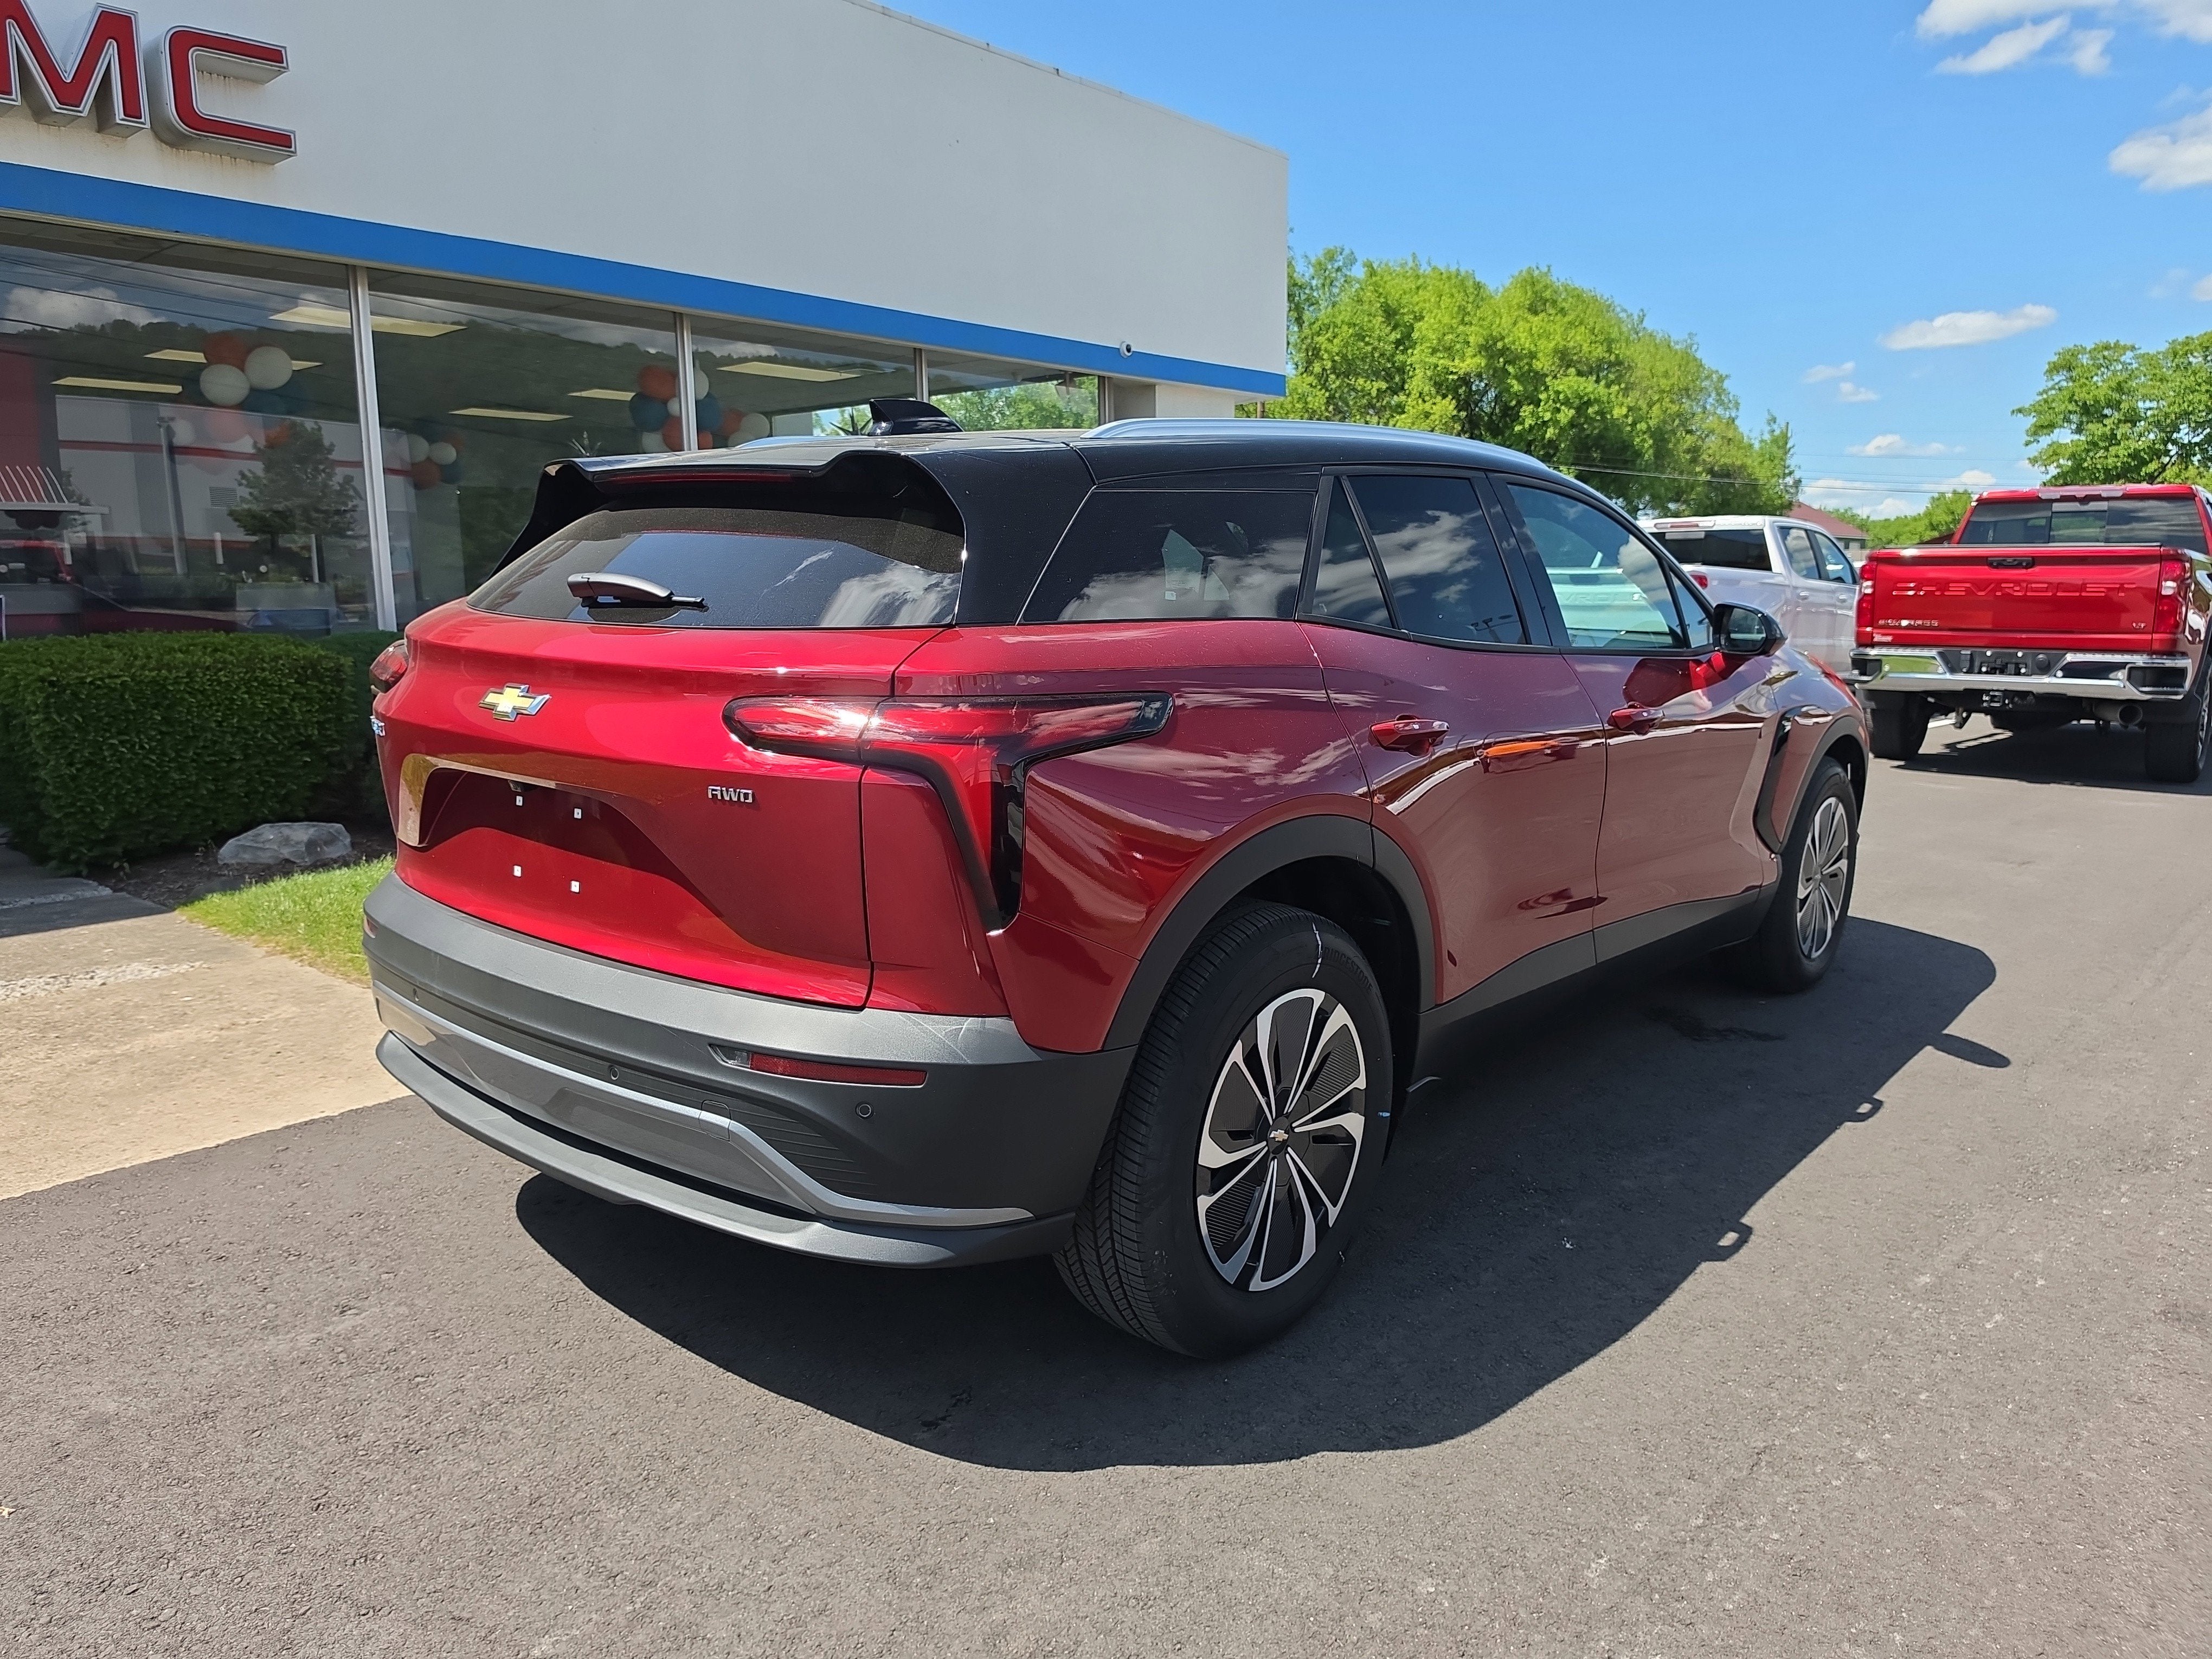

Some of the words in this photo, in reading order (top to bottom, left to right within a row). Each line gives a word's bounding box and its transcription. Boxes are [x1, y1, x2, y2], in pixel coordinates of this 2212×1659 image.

[1892, 582, 2137, 596] CHEVROLET
[708, 786, 753, 803] AWD
[1317, 944, 1373, 994] RIDGESTONE
